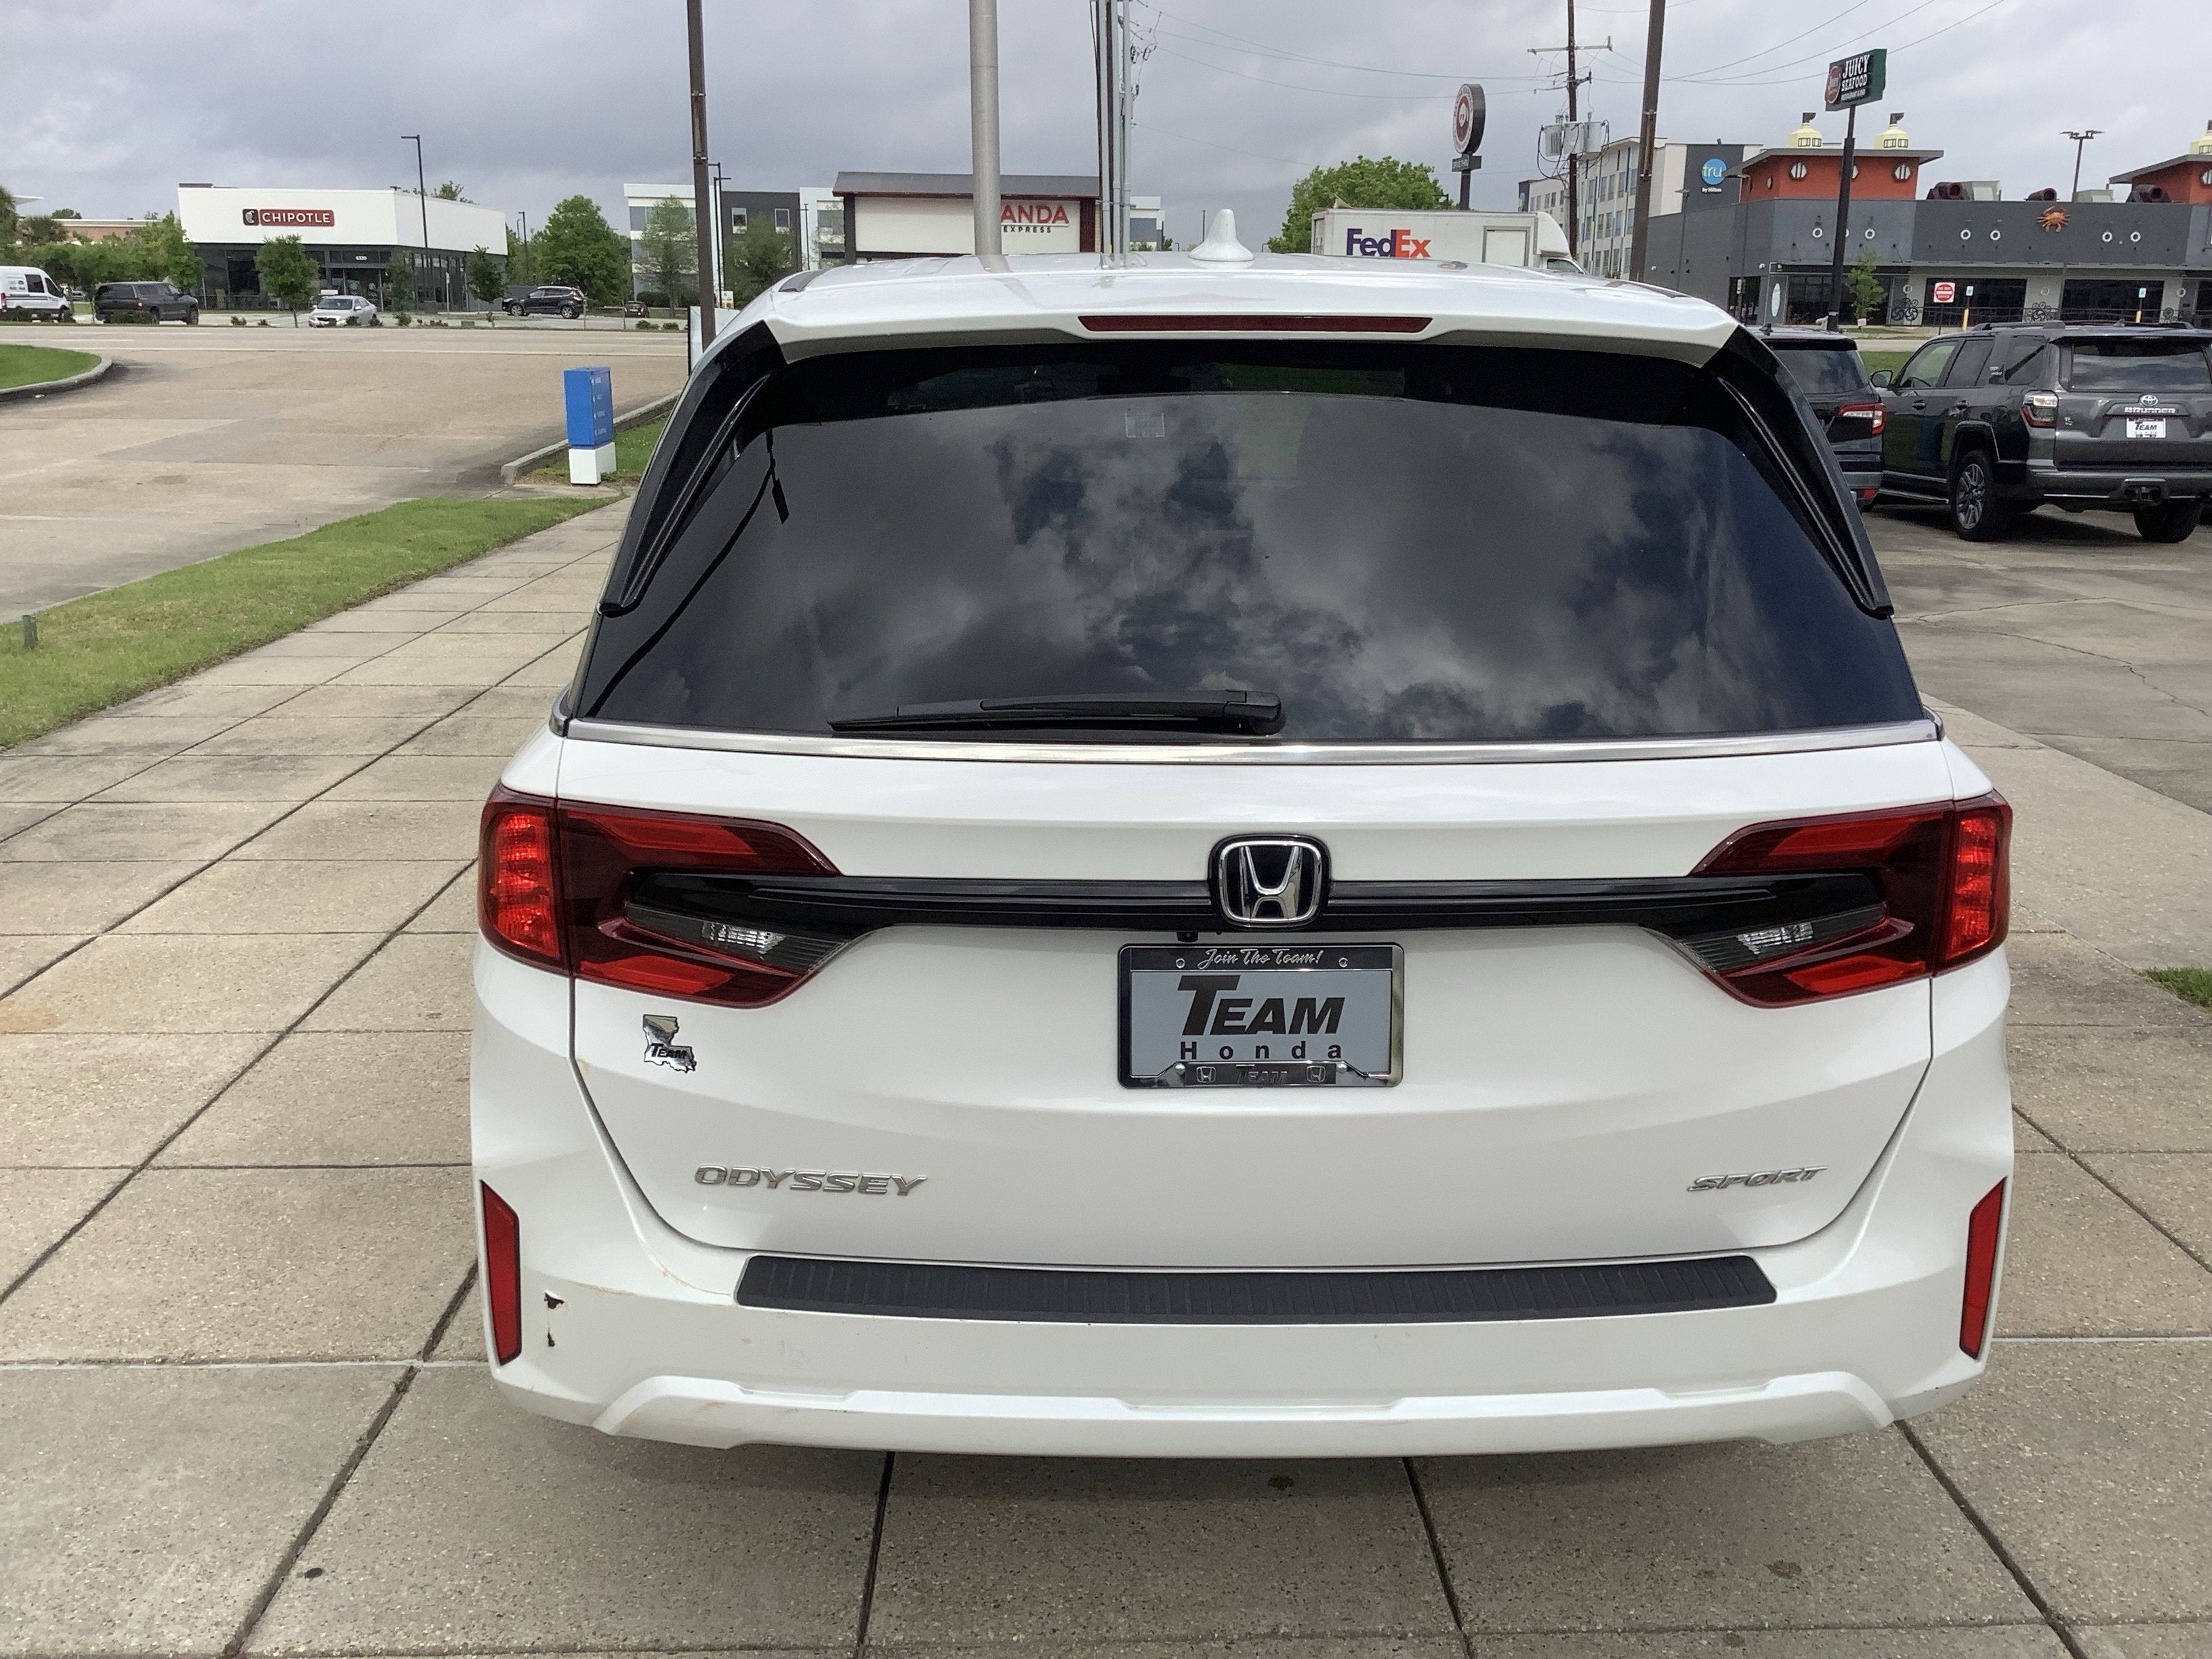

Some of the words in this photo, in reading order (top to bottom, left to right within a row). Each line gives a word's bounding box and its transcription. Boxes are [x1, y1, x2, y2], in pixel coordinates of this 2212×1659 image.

[1843, 54, 1870, 79] JUICY
[1841, 74, 1868, 91] SEAFOOD
[1702, 163, 1722, 178] tru
[262, 212, 331, 223] CHIPOTLE
[1000, 205, 1069, 224] ANDA
[1346, 228, 1431, 258] FedEx
[2135, 422, 2157, 430] TEAM
[1197, 949, 1238, 969] Join
[1240, 949, 1271, 965] The
[1274, 949, 1322, 965] Team!
[1176, 975, 1346, 1036] TEAM
[651, 1043, 688, 1059] TEAM
[1180, 1040, 1343, 1061] Honda
[695, 1164, 928, 1196] ODYSSEY
[1686, 1165, 1829, 1191] SPORT
